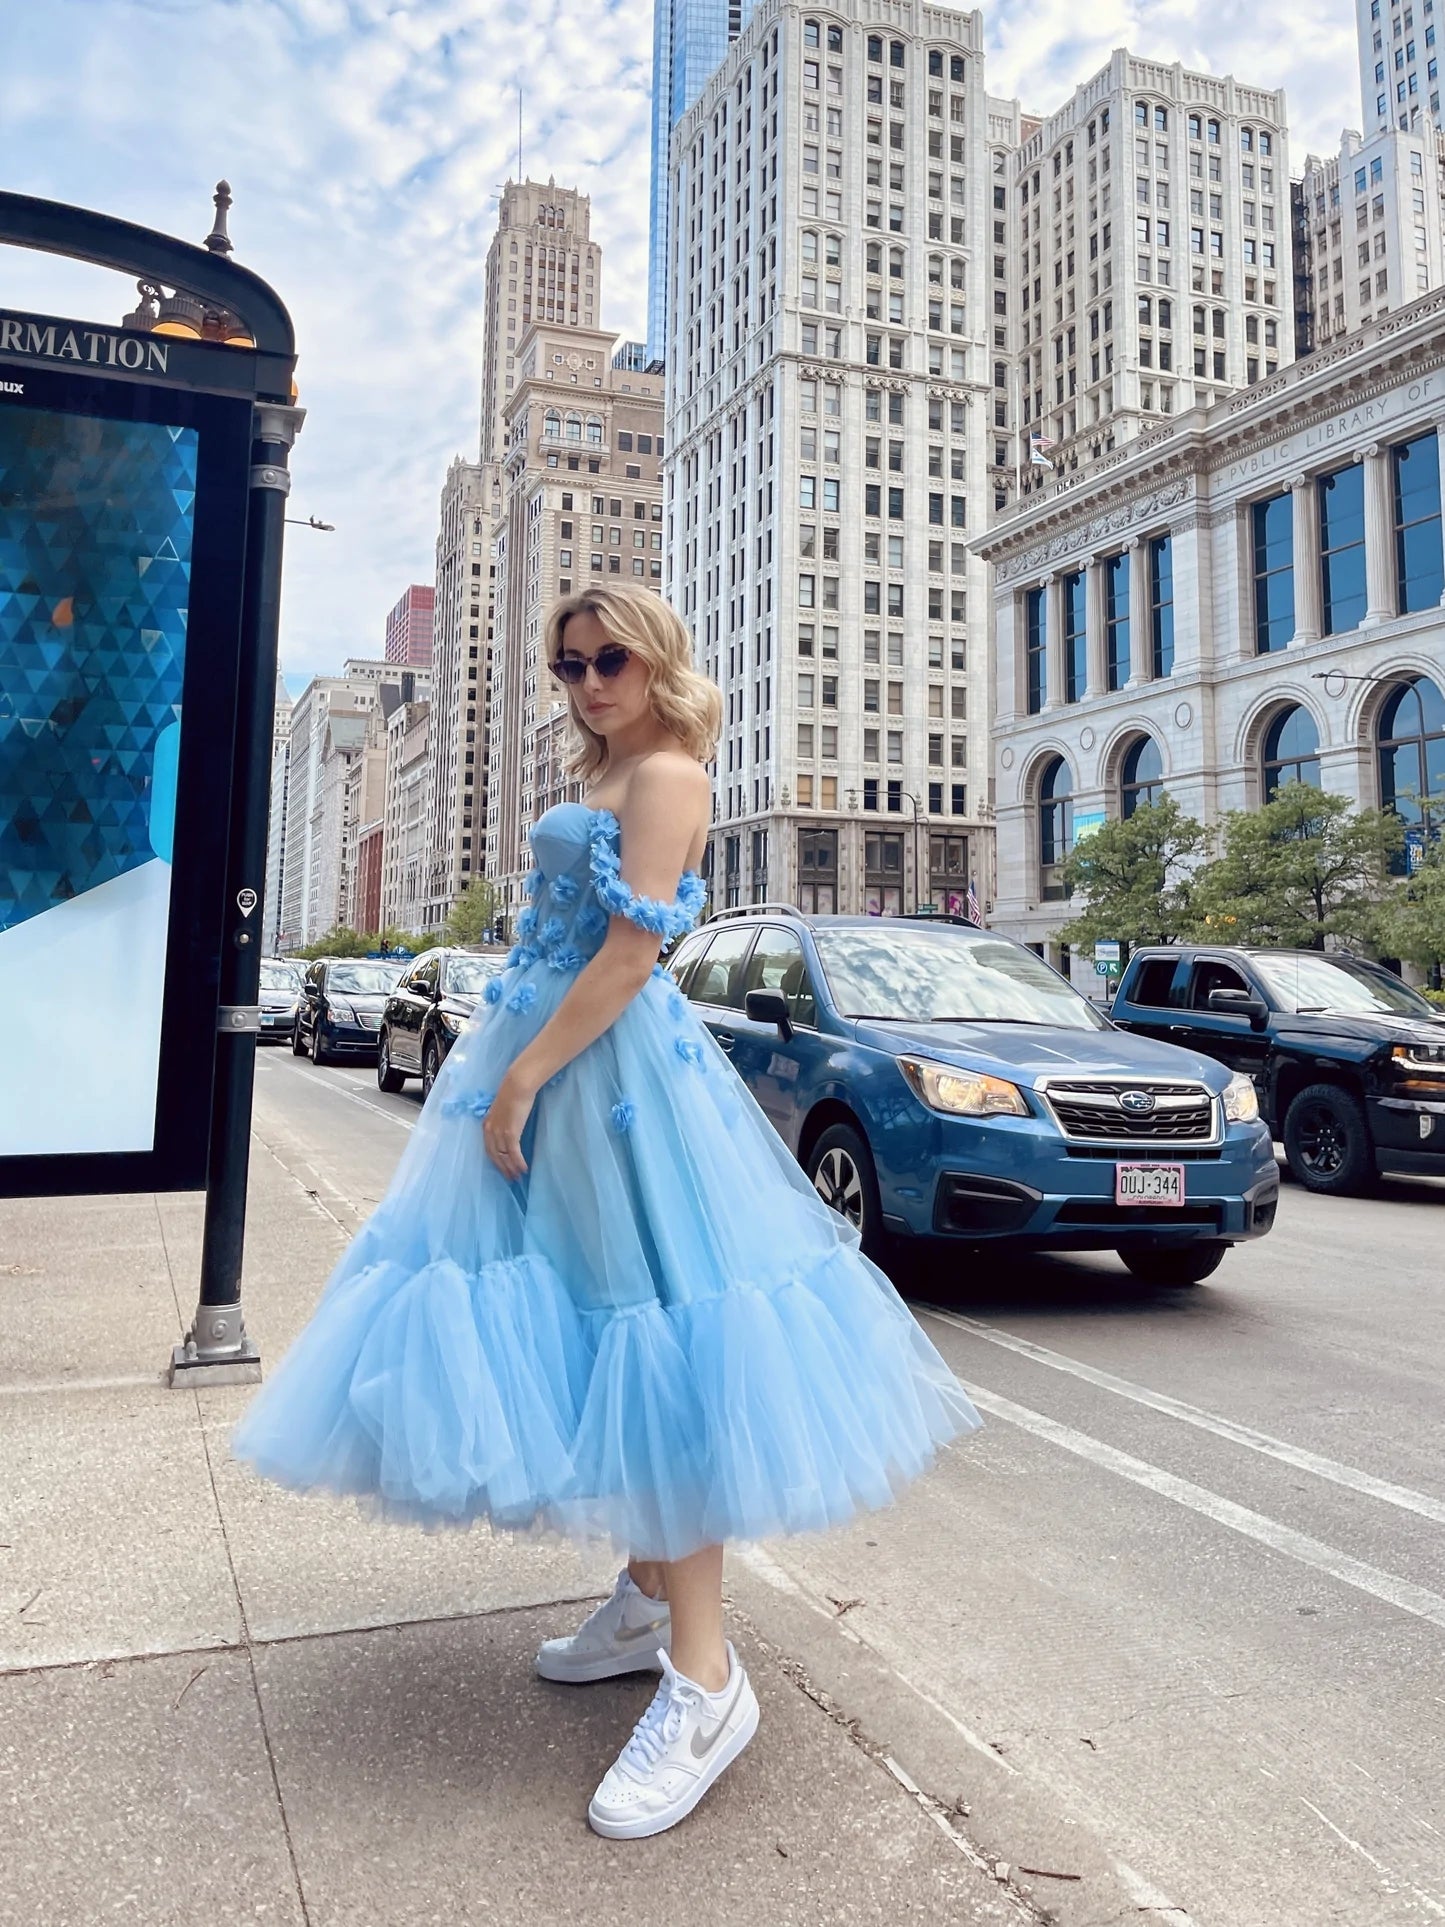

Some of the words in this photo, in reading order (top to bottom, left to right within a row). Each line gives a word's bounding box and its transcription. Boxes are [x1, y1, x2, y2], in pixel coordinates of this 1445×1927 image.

[0, 319, 170, 373] RMATION
[1230, 443, 1290, 479] PVBLIC
[1306, 398, 1388, 448] LIBRARY
[1408, 378, 1434, 401] OF
